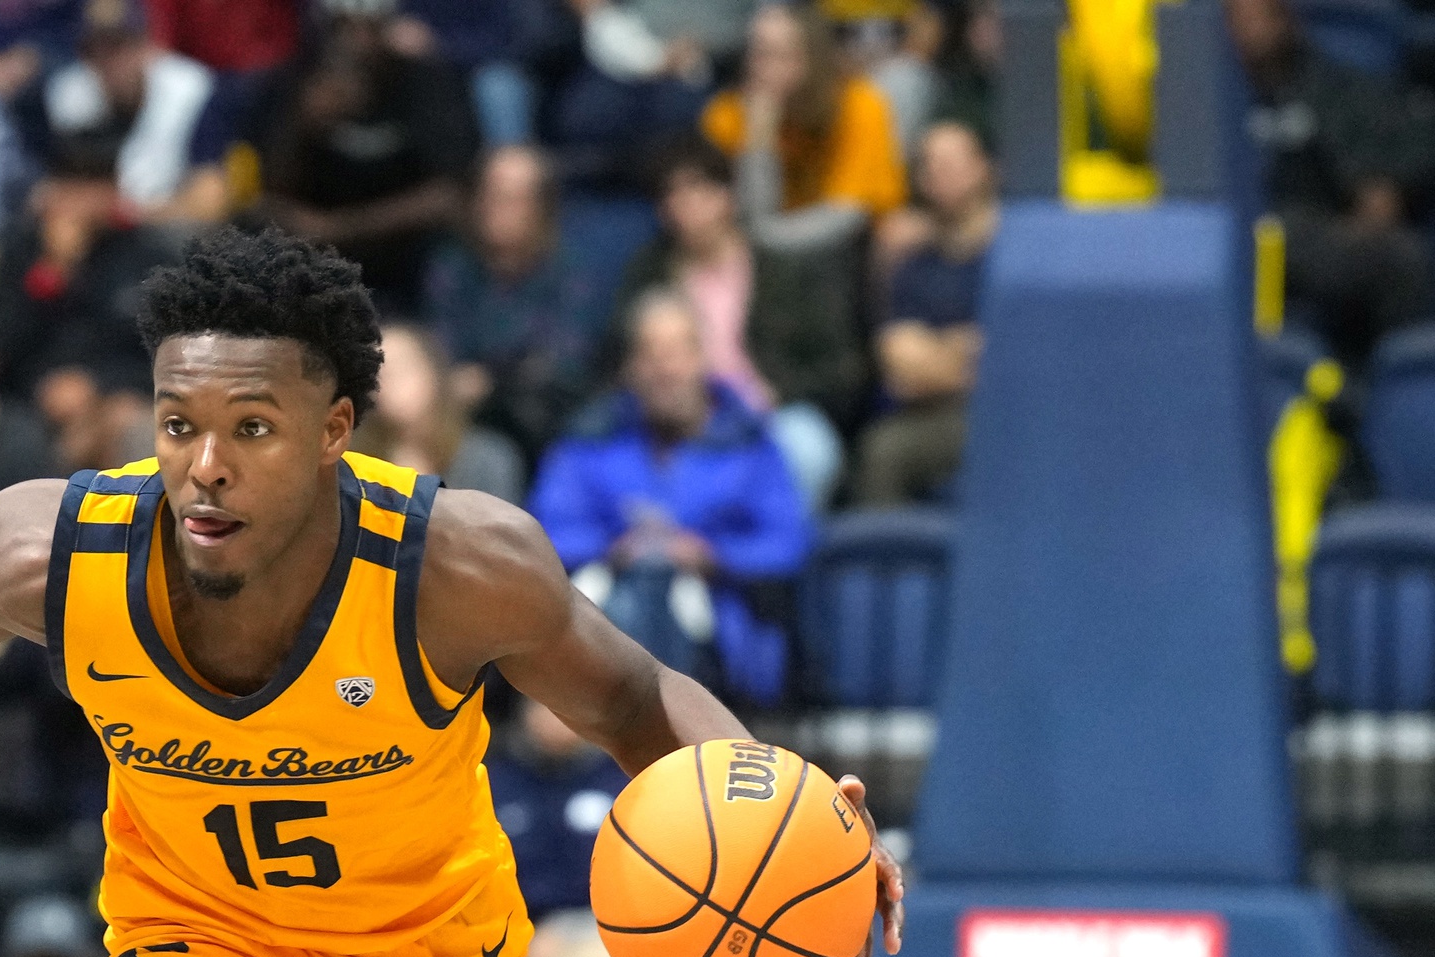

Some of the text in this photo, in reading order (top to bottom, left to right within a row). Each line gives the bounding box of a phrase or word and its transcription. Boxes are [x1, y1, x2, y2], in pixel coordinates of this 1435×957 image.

[336, 679, 373, 698] PAC
[347, 691, 367, 703] 12
[93, 714, 415, 778] Golden Bears
[202, 799, 342, 891] 15
